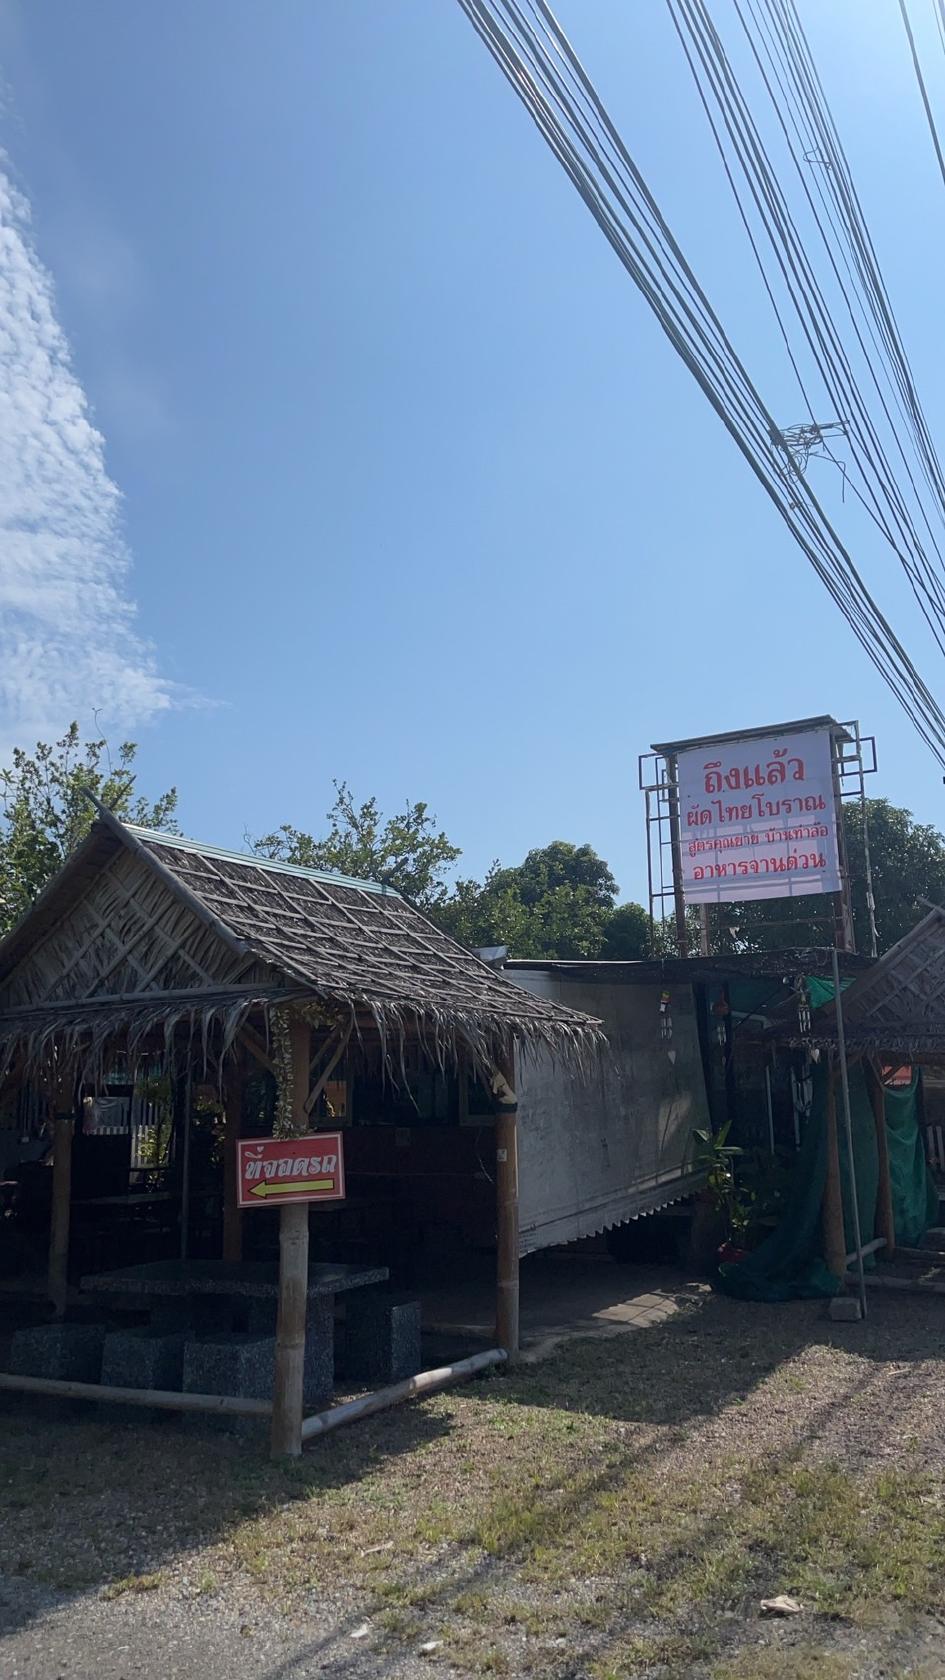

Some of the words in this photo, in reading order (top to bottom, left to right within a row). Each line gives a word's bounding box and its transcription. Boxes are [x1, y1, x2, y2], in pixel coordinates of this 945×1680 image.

[704, 748, 806, 794] ถึงแล้ว
[687, 793, 826, 827] ผัดไทยโบราณ
[693, 848, 826, 881] อาหารจานด่วน
[244, 1146, 337, 1180] ที่จอดรถ
